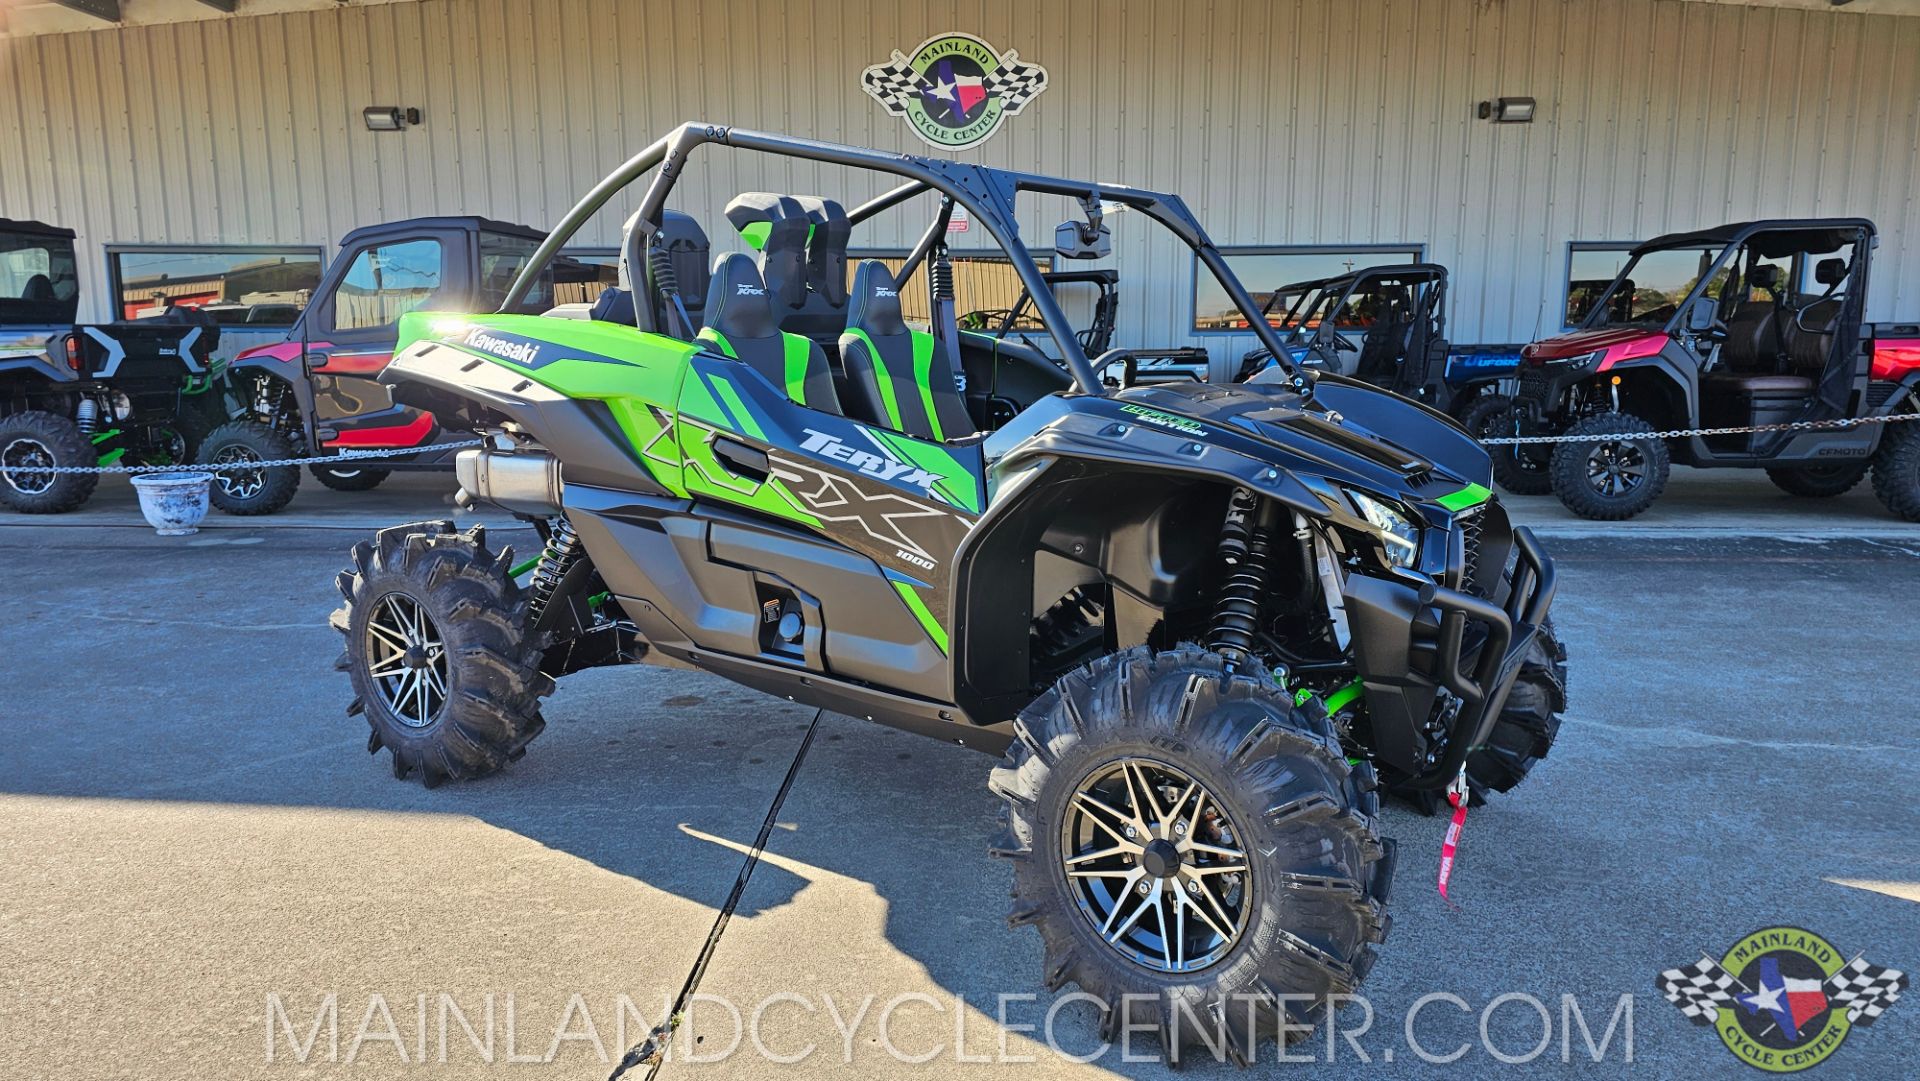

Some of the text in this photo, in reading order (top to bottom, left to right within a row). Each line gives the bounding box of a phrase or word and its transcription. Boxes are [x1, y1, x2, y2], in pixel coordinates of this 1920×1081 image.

[920, 42, 990, 65] MAINLAND
[914, 109, 997, 141] CYCLE CENTER
[463, 328, 541, 365] Kawasaki
[1478, 359, 1521, 367] UFORC
[1818, 443, 1867, 457] CFMOTO
[896, 550, 935, 571] 1000
